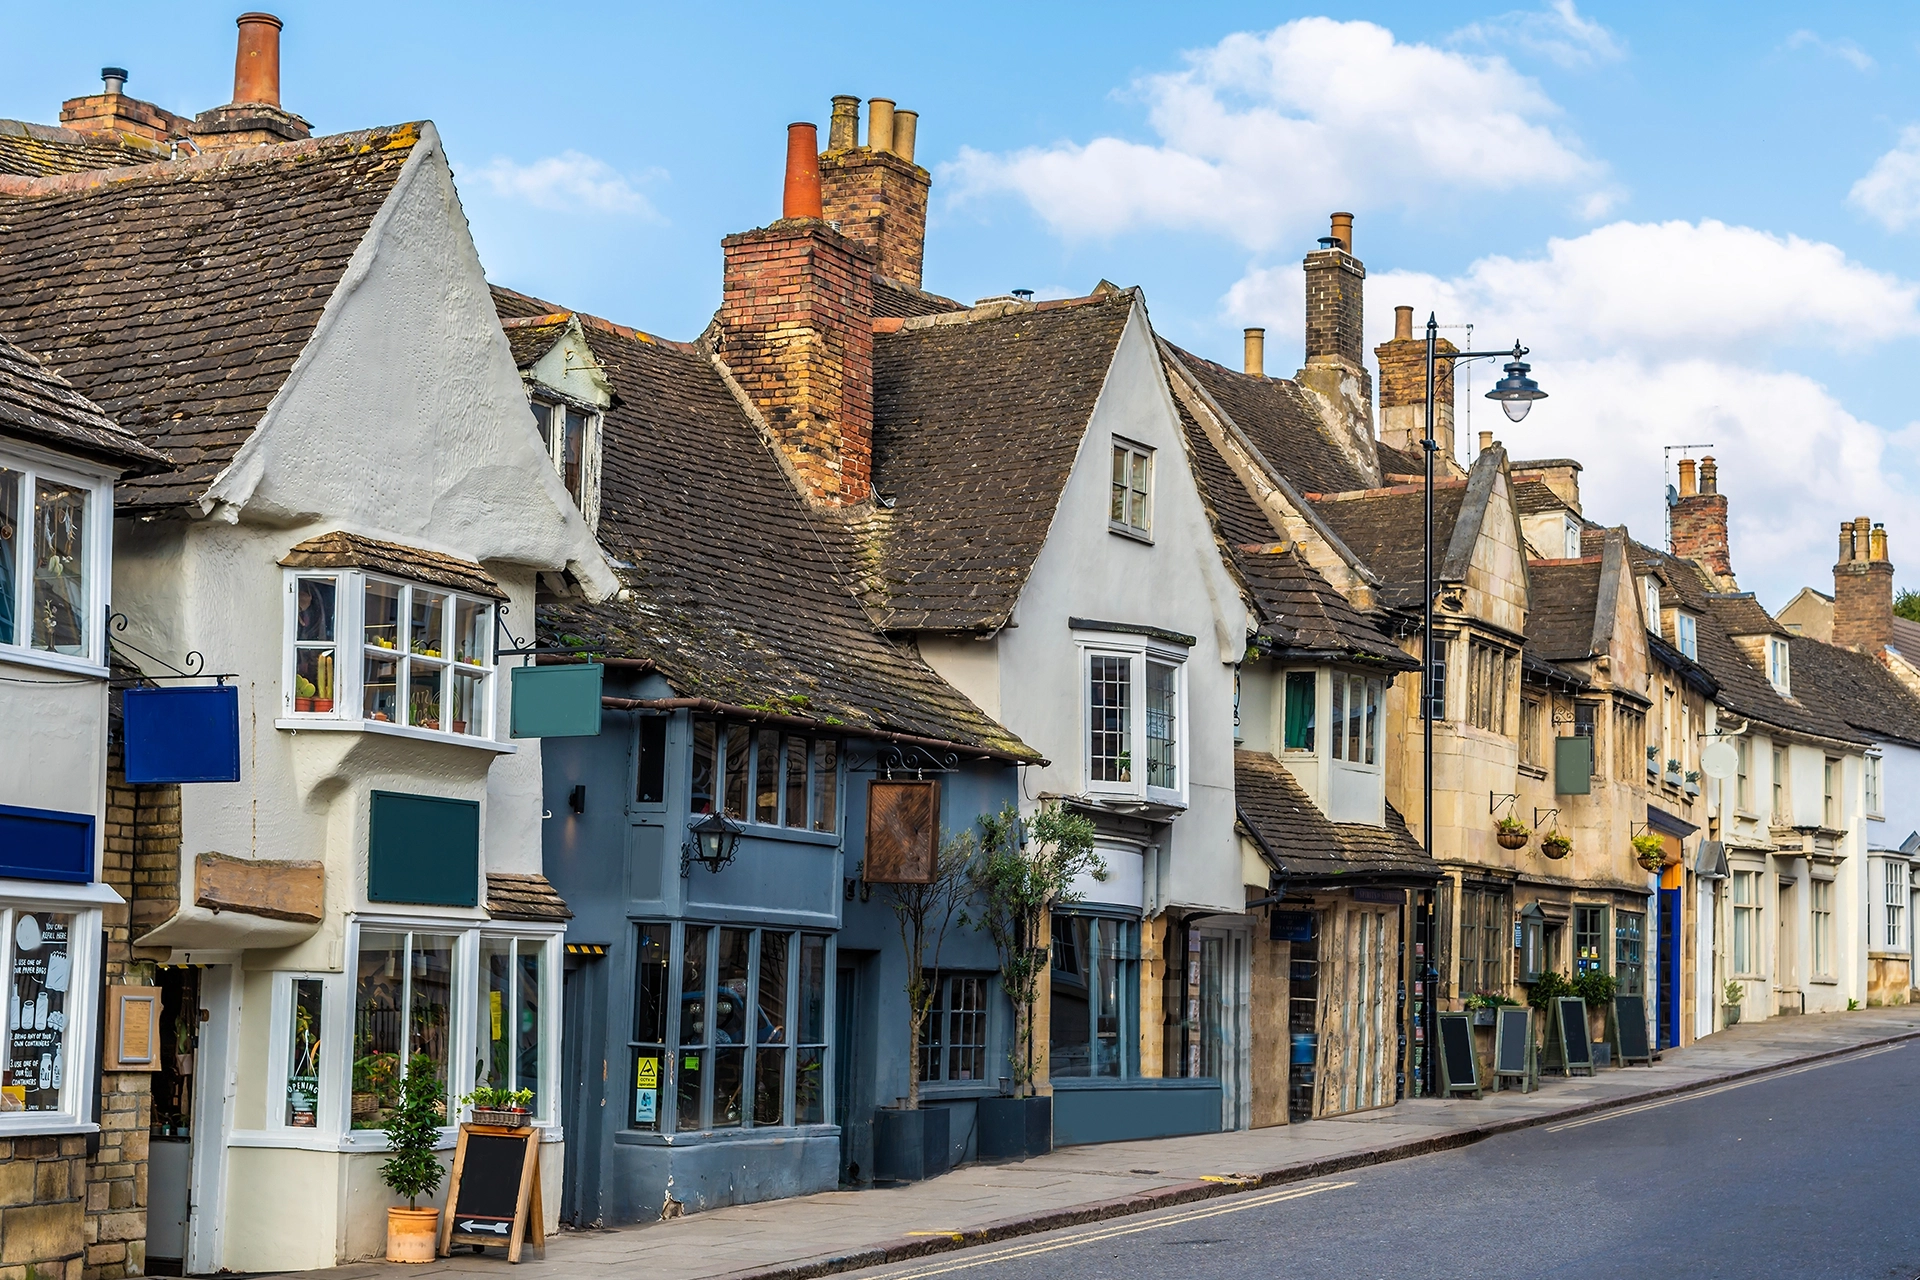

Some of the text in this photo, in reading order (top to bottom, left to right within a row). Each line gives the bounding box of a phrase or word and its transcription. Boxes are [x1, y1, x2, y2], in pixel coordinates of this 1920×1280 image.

[56, 931, 67, 940] HERE
[185, 953, 190, 963] 7
[15, 1069, 24, 1077] OUR
[12, 1078, 37, 1086] CONTAINERS
[287, 1081, 319, 1094] OPENING
